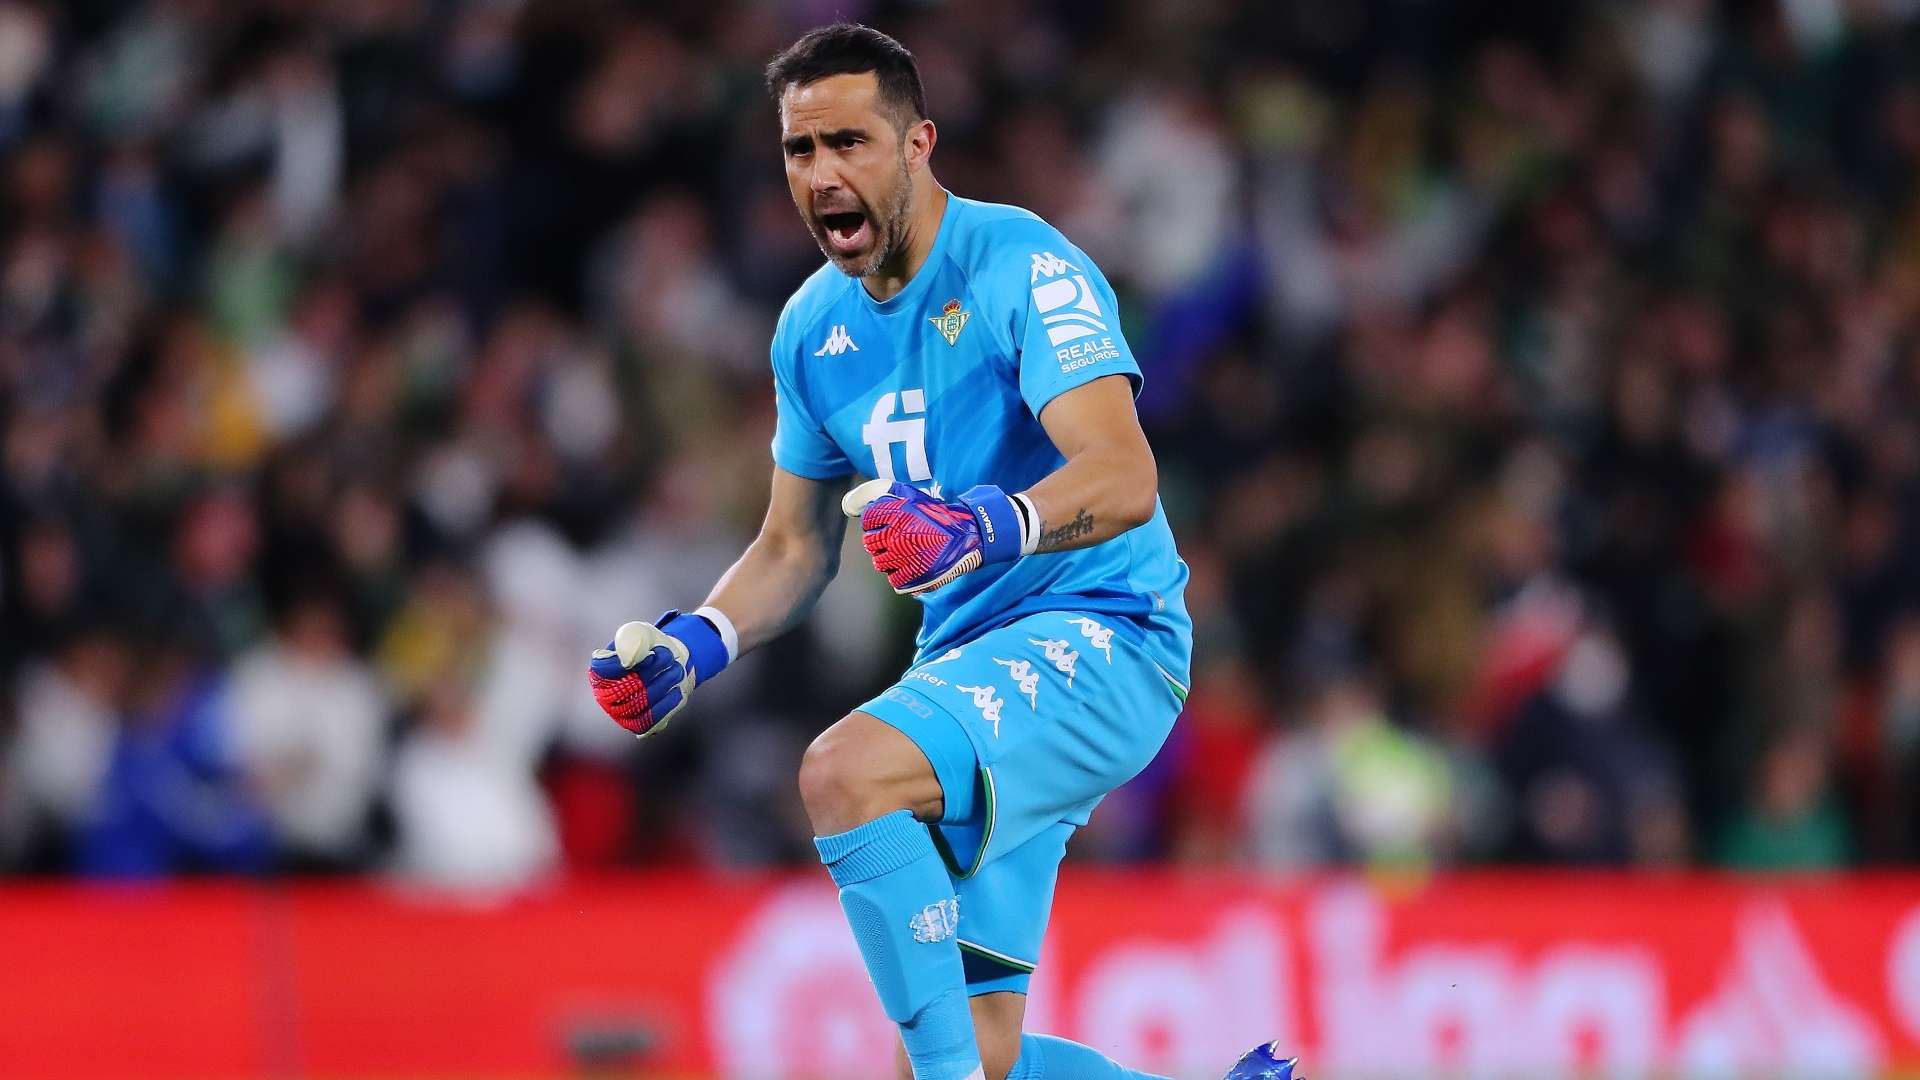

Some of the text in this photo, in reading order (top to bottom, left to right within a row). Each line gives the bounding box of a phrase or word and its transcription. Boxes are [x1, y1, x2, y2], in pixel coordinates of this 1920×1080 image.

[1056, 337, 1115, 363] REALE
[1061, 350, 1120, 374] SEGUROS
[863, 389, 932, 482] fi
